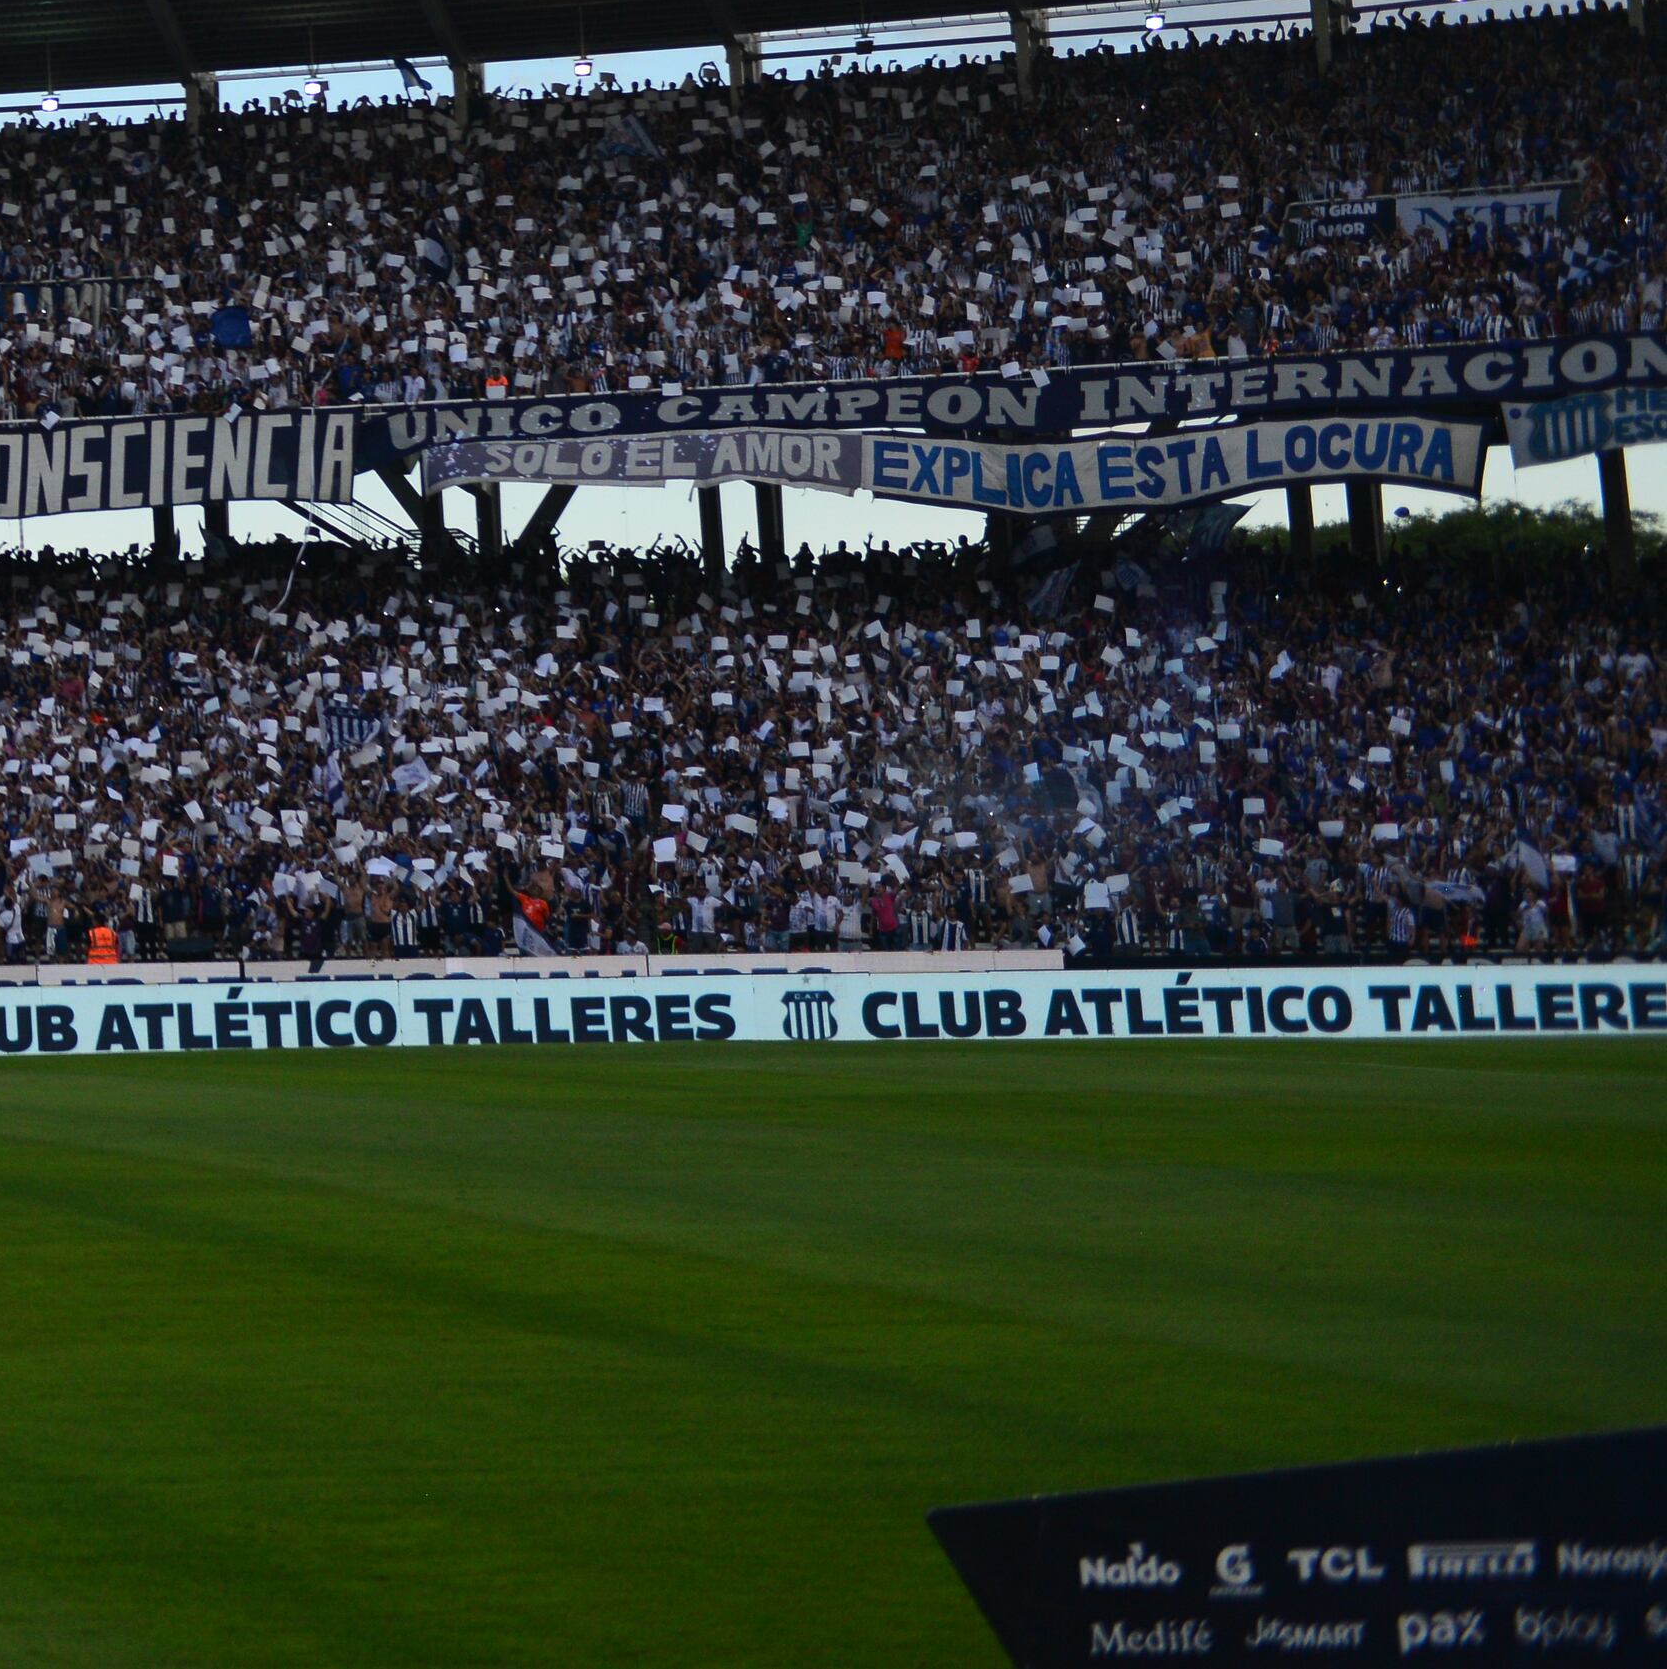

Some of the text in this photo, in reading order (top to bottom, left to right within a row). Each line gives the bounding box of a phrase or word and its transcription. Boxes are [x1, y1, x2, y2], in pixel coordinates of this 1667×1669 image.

[1329, 202, 1377, 217] GRAN
[657, 378, 1042, 427] CAMPEÓN
[485, 432, 842, 481] SOLO EL AMOR
[874, 422, 1455, 509] EXPLICA ESTA LOCURA
[96, 987, 398, 1052] ATLÉTICO
[414, 993, 737, 1045] TALLERES
[862, 989, 1028, 1039] CLUB
[1045, 972, 1353, 1035] ATLÉTICO
[1078, 1542, 1182, 1589] Naldo
[1286, 1543, 1388, 1584] TCL
[1089, 1616, 1215, 1656] Medifé
